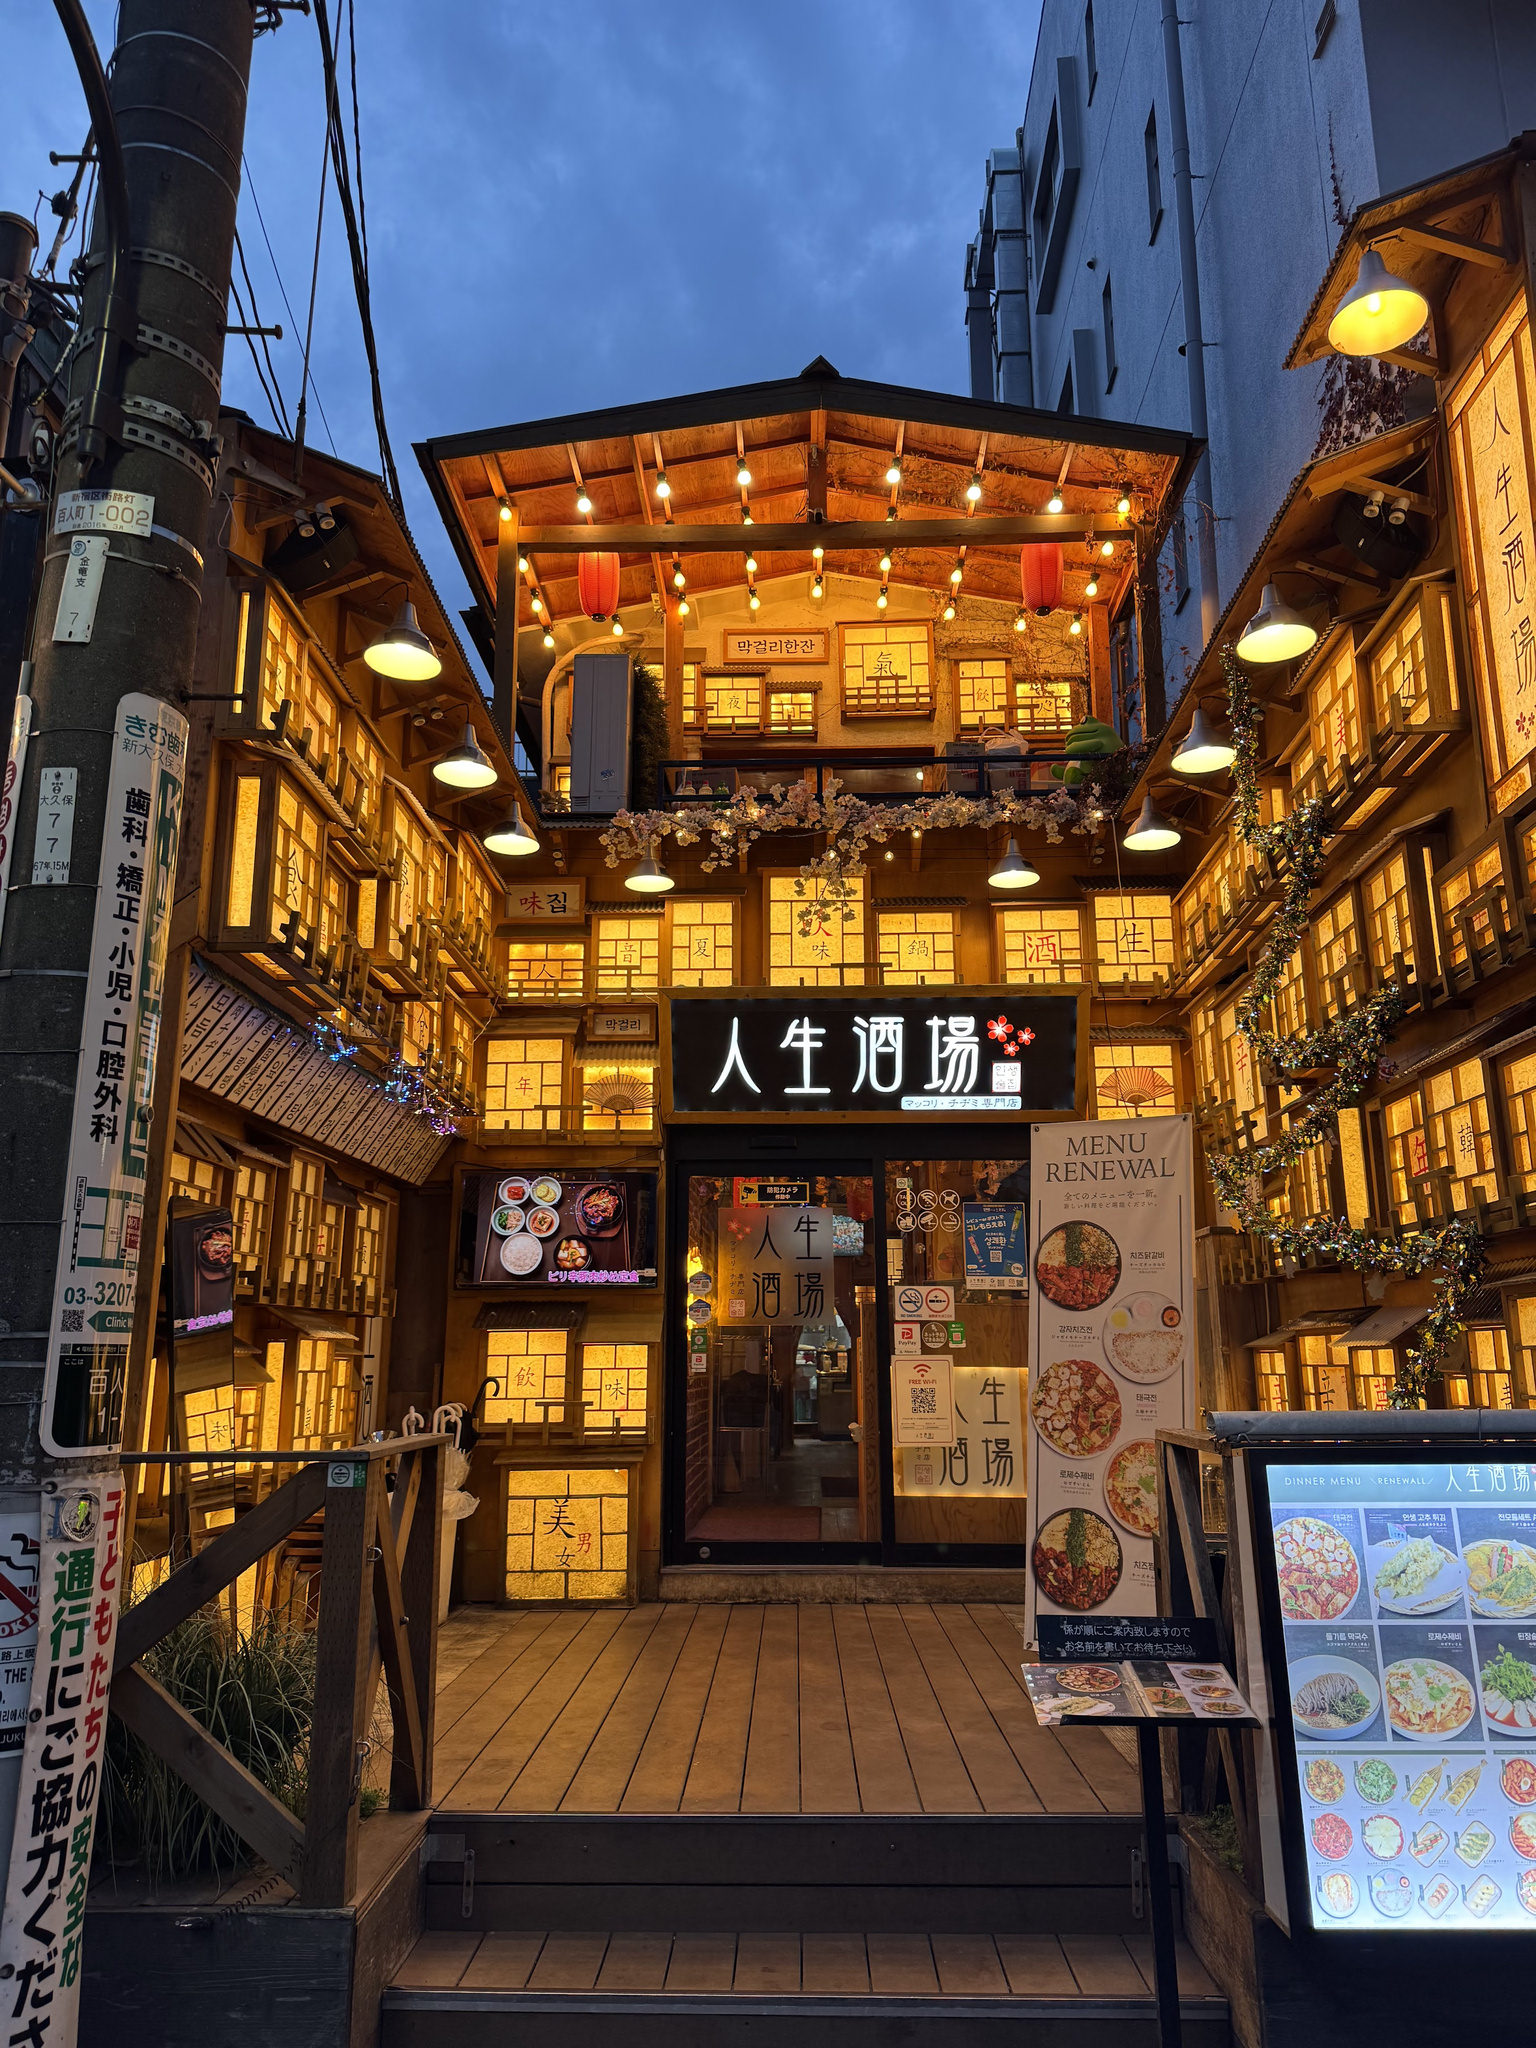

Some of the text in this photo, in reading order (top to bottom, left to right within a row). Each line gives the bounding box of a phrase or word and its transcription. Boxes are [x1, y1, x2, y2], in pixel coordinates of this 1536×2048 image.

[57, 504, 150, 527] 百人町1-002
[69, 612, 79, 625] 7
[737, 638, 816, 655] 막걸리한잔
[727, 694, 742, 710] 夜
[40, 795, 74, 807] 大久保
[49, 813, 61, 829] 7
[47, 838, 59, 853] 7
[519, 891, 568, 916] 味집
[692, 938, 712, 957] 夏
[1119, 922, 1151, 953] 生
[811, 941, 831, 961] 味
[907, 939, 929, 957] 鍋
[1027, 934, 1057, 963] 酒
[89, 787, 152, 1145] 歯科・矯正・小児・口腔外科
[535, 963, 556, 979] 人
[605, 1018, 642, 1032] 막걸리
[711, 1016, 980, 1093] 人生酒場
[515, 1076, 534, 1096] 年
[1066, 1133, 1148, 1157] MENU
[1045, 1157, 1176, 1183] RENEWAL
[753, 1214, 824, 1260] 人生
[751, 1272, 825, 1319] 酒場
[105, 1317, 127, 1328] Clinic
[514, 1366, 536, 1387] 飲
[604, 1378, 626, 1400] 味
[1284, 1477, 1325, 1486] DINNER
[1330, 1477, 1361, 1486] MENU
[1446, 1465, 1531, 1492] 人生酒場
[542, 1498, 576, 1539] 美
[576, 1532, 592, 1554] 男
[555, 1547, 576, 1567] 女
[1063, 1624, 1191, 1637] 係が順にご案内致しますので
[1064, 1640, 1193, 1653] お名前を書いてお待ち下さい
[5, 1667, 27, 1684] THE
[58, 1490, 122, 1988] 子どもたちの安全な
